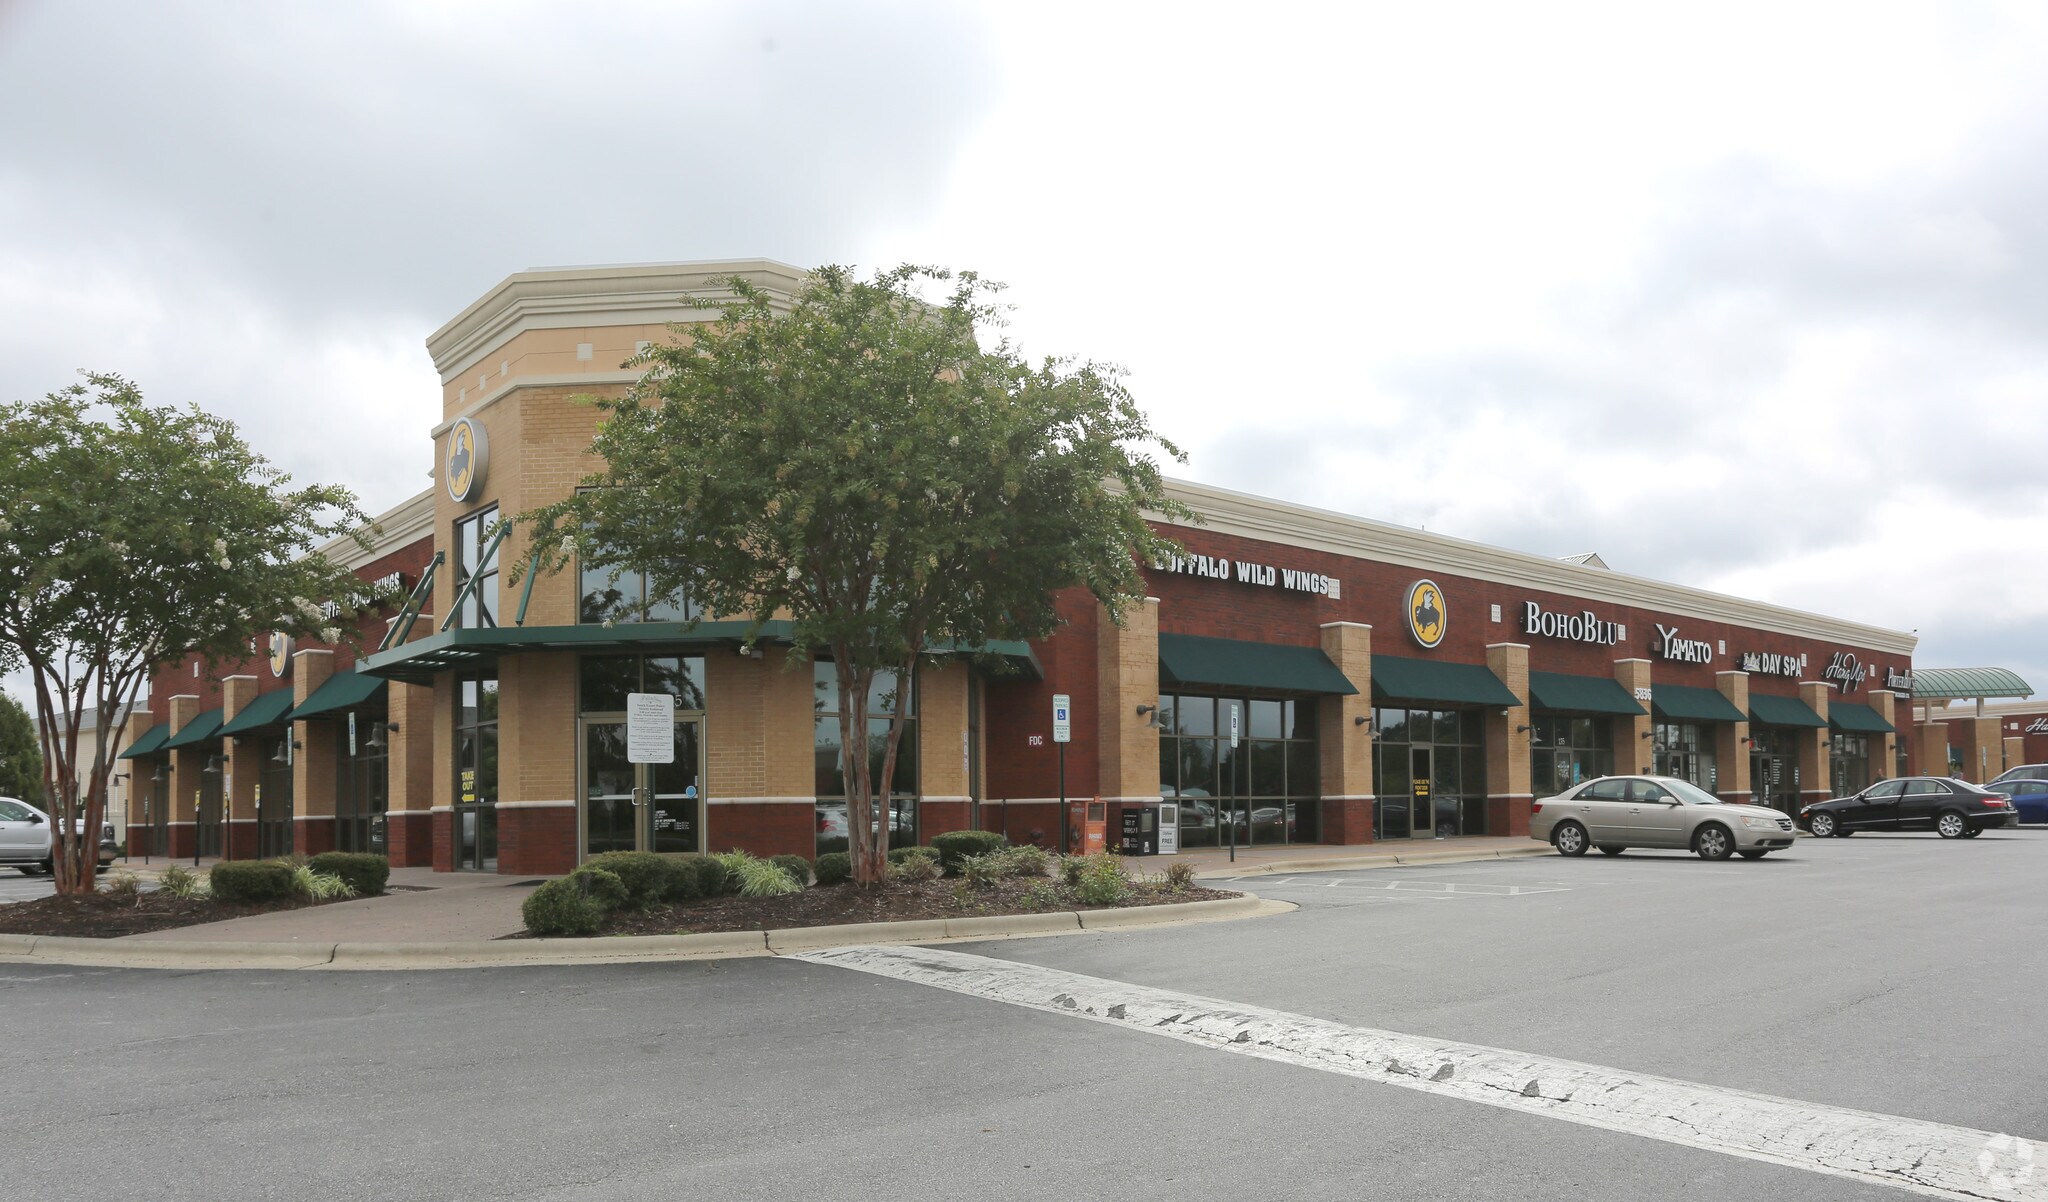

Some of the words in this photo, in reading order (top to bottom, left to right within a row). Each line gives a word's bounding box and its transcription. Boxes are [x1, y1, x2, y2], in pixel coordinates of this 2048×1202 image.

[1235, 561, 1276, 587] WILD
[1281, 568, 1329, 595] WINGS
[1655, 623, 1712, 664] YAMATO
[1762, 652, 1781, 675] DAY
[1783, 655, 1802, 678] SPA
[1029, 735, 1043, 745] FDC
[461, 770, 475, 781] TAKE
[462, 780, 474, 791] OUT
